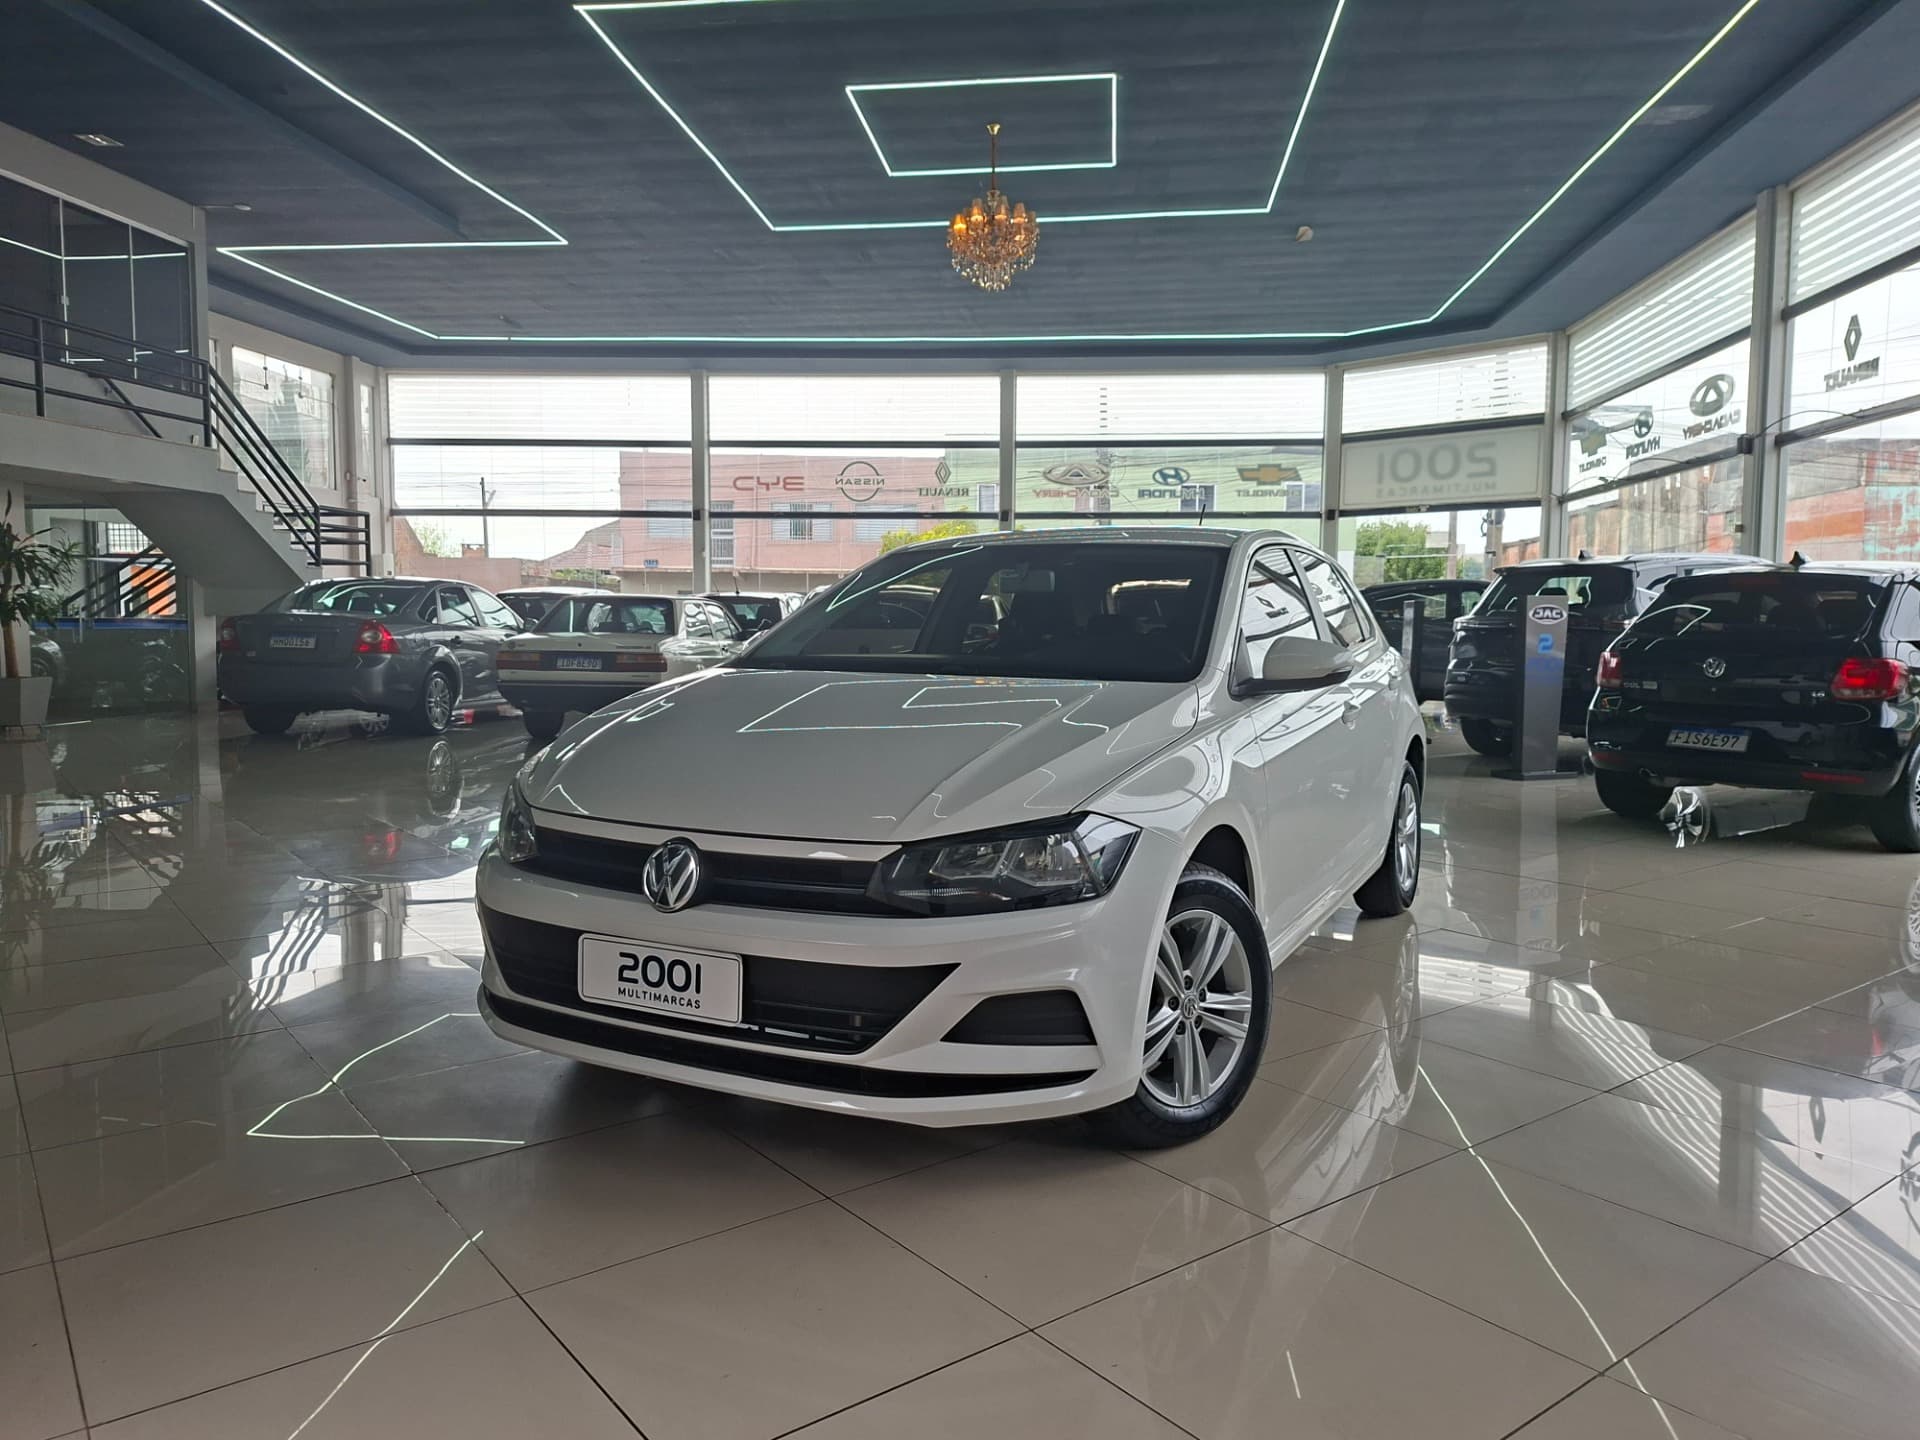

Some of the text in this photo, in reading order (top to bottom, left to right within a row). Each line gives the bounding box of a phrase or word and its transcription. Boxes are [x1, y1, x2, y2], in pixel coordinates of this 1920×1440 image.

[1534, 608, 1561, 619] JAC
[618, 952, 701, 995] 2001
[618, 987, 701, 1009] MULTIMARCAS
